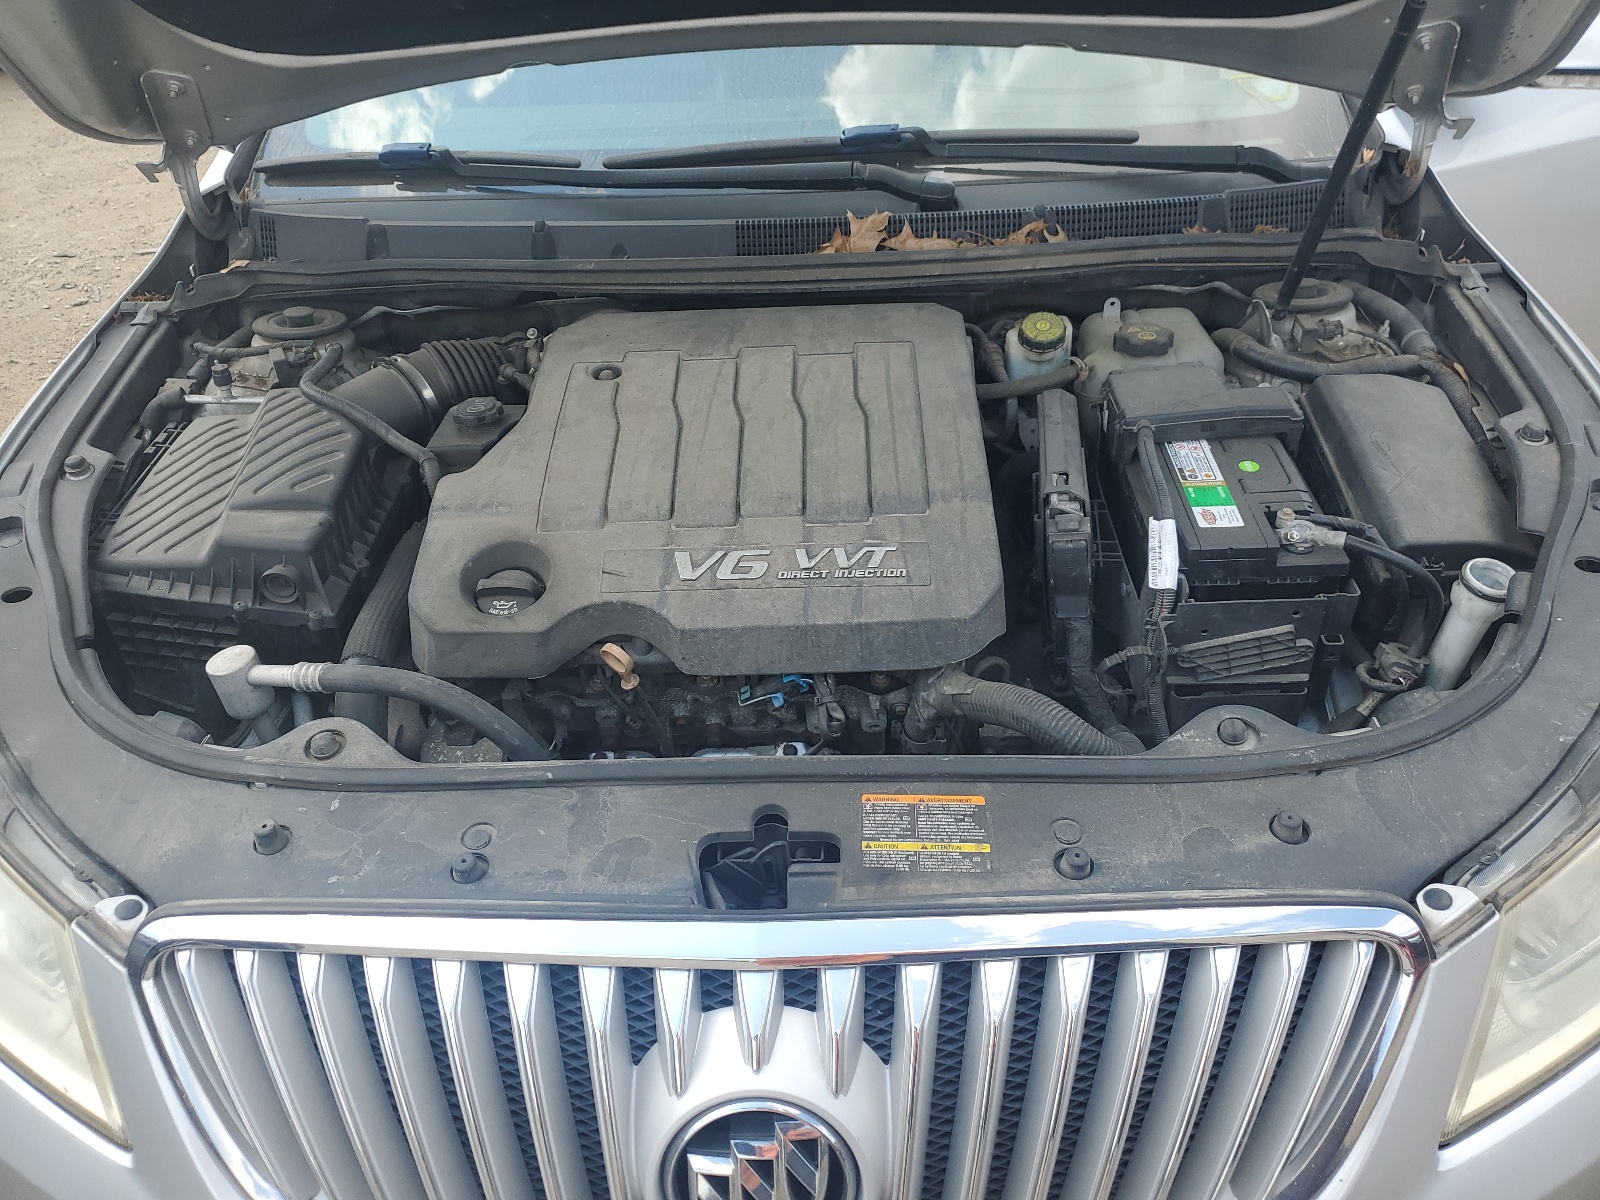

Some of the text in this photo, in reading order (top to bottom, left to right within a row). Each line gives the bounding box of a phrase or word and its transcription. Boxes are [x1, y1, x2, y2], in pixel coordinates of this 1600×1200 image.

[675, 546, 898, 581] V6 VVT
[778, 568, 907, 579] DIRECT INJECTION
